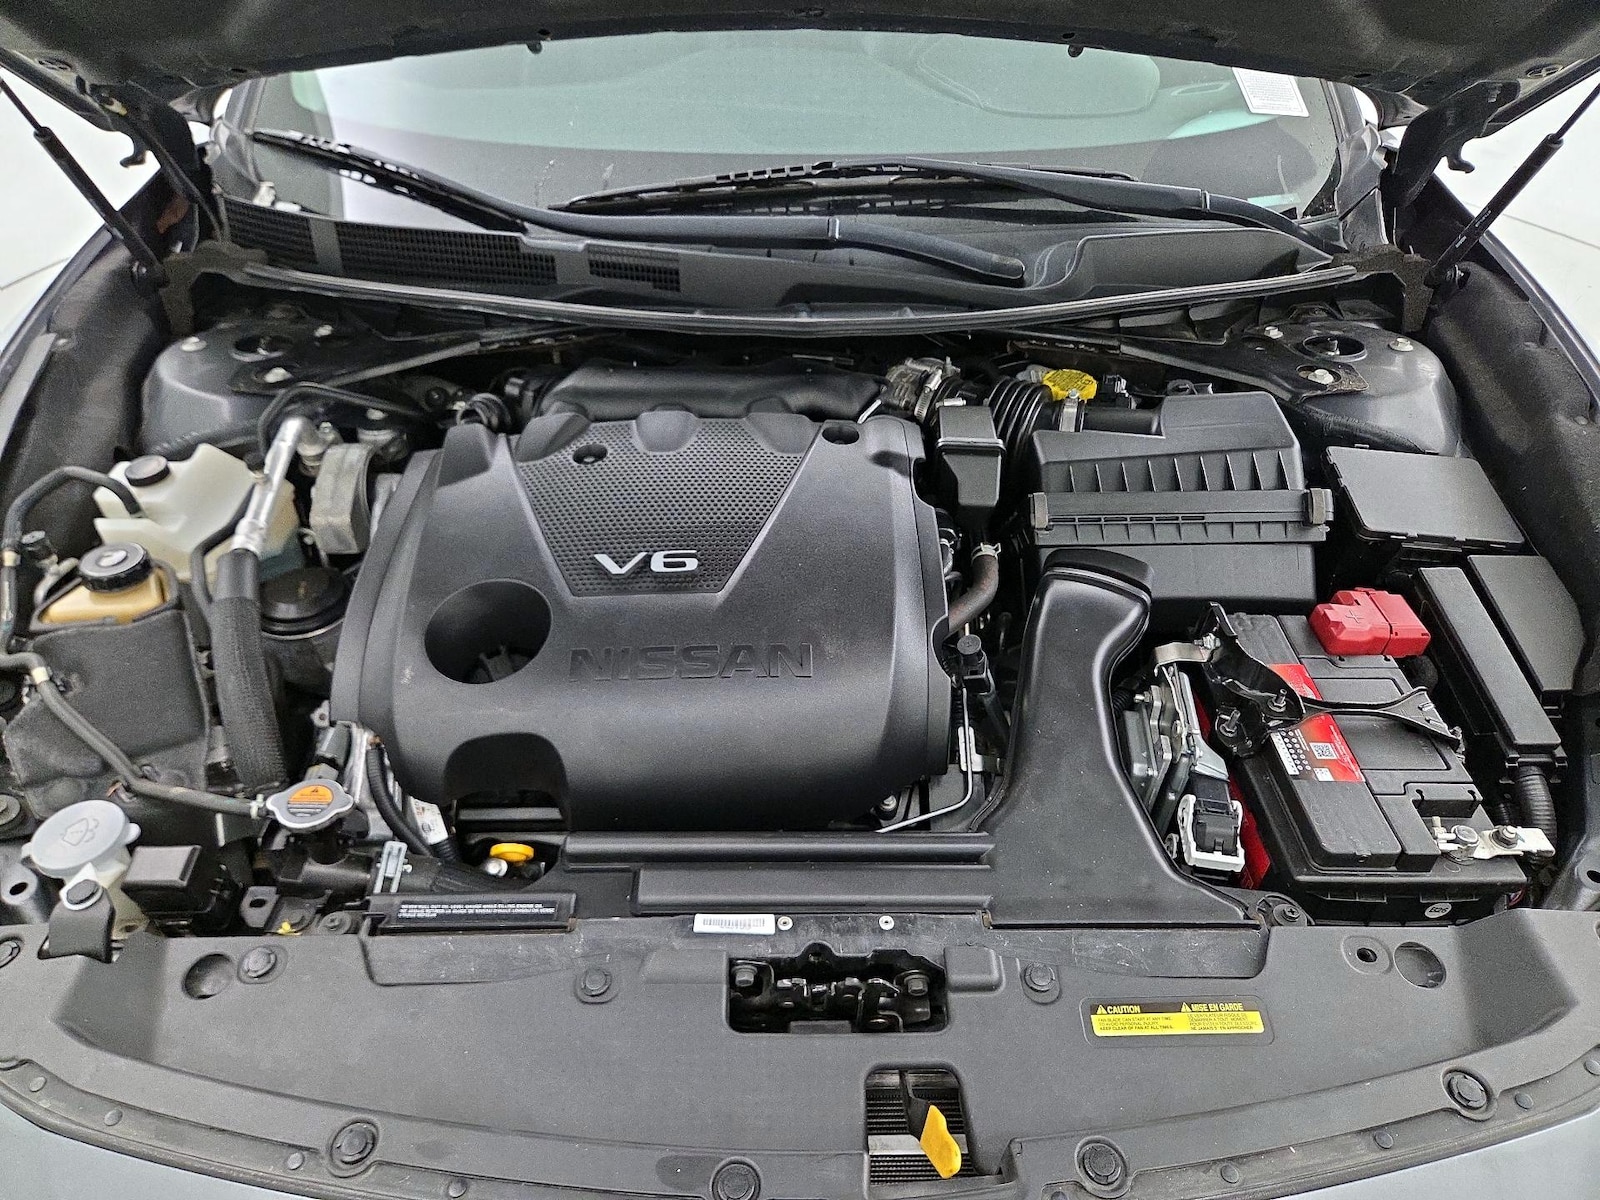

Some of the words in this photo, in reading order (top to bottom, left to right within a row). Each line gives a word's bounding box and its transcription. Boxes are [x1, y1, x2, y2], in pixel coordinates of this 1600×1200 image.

[594, 550, 699, 575] V6
[569, 643, 813, 682] NISSAN
[1106, 1005, 1141, 1013] CAUTION
[1209, 1003, 1219, 1011] EN
[1219, 1003, 1244, 1011] GARDE
